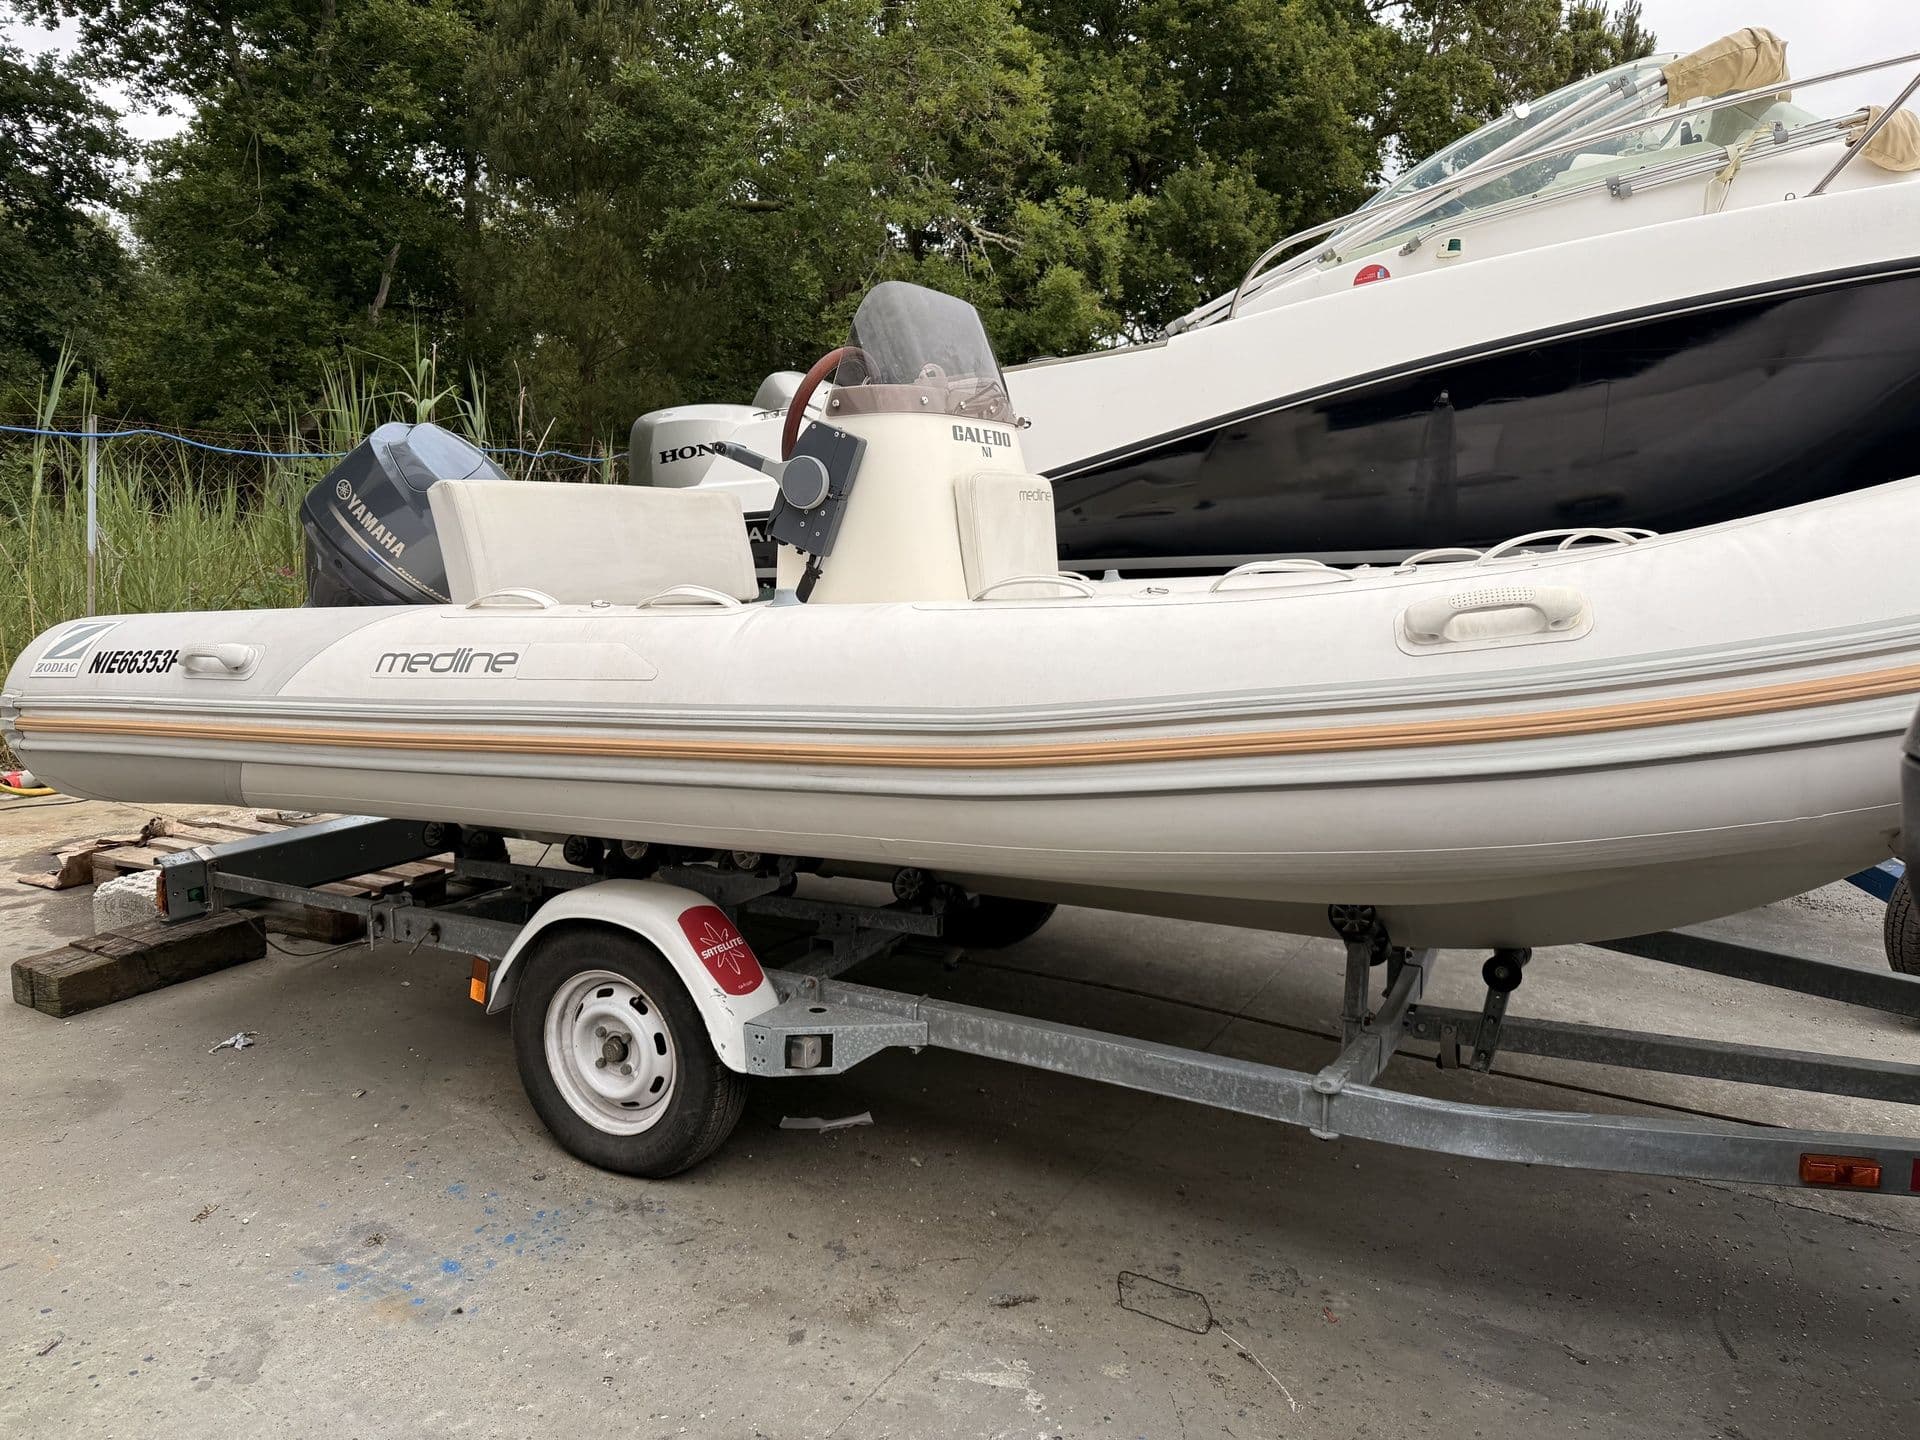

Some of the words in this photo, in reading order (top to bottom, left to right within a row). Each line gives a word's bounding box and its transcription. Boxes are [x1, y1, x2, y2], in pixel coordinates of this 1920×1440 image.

[952, 425, 1011, 447] CALEDO
[347, 493, 405, 558] YAMAHA
[35, 662, 78, 673] ZODIAC
[375, 647, 519, 673] medline
[701, 936, 744, 960] SATELLITE
